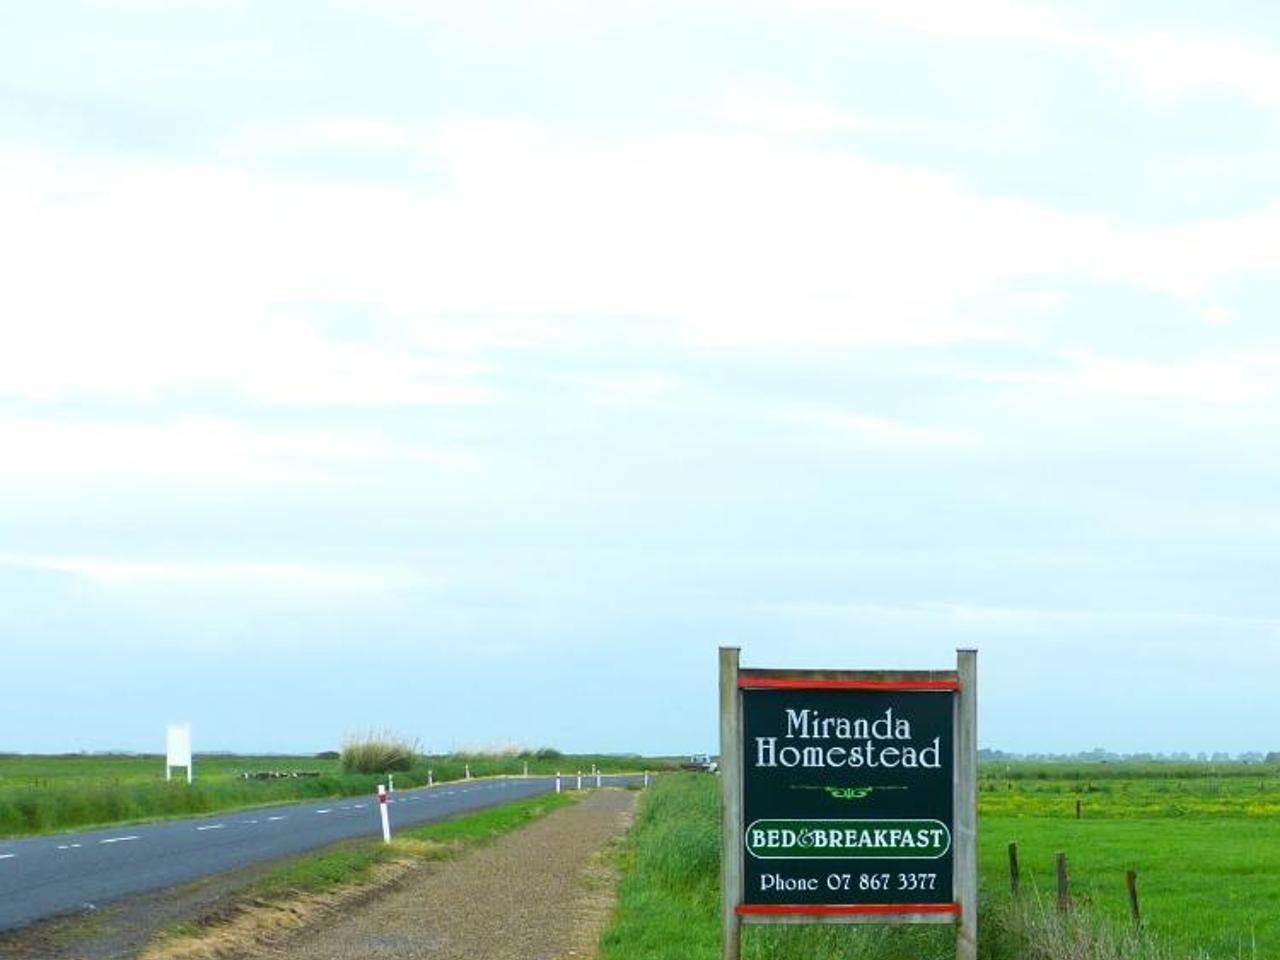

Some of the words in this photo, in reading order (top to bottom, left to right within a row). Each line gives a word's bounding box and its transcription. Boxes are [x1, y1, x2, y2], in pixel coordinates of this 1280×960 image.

[785, 707, 912, 740] Miranda
[755, 736, 942, 768] Homestead
[760, 874, 819, 891] Phone
[827, 874, 850, 890] 07
[859, 874, 890, 890] 867
[897, 874, 937, 890] 3377
